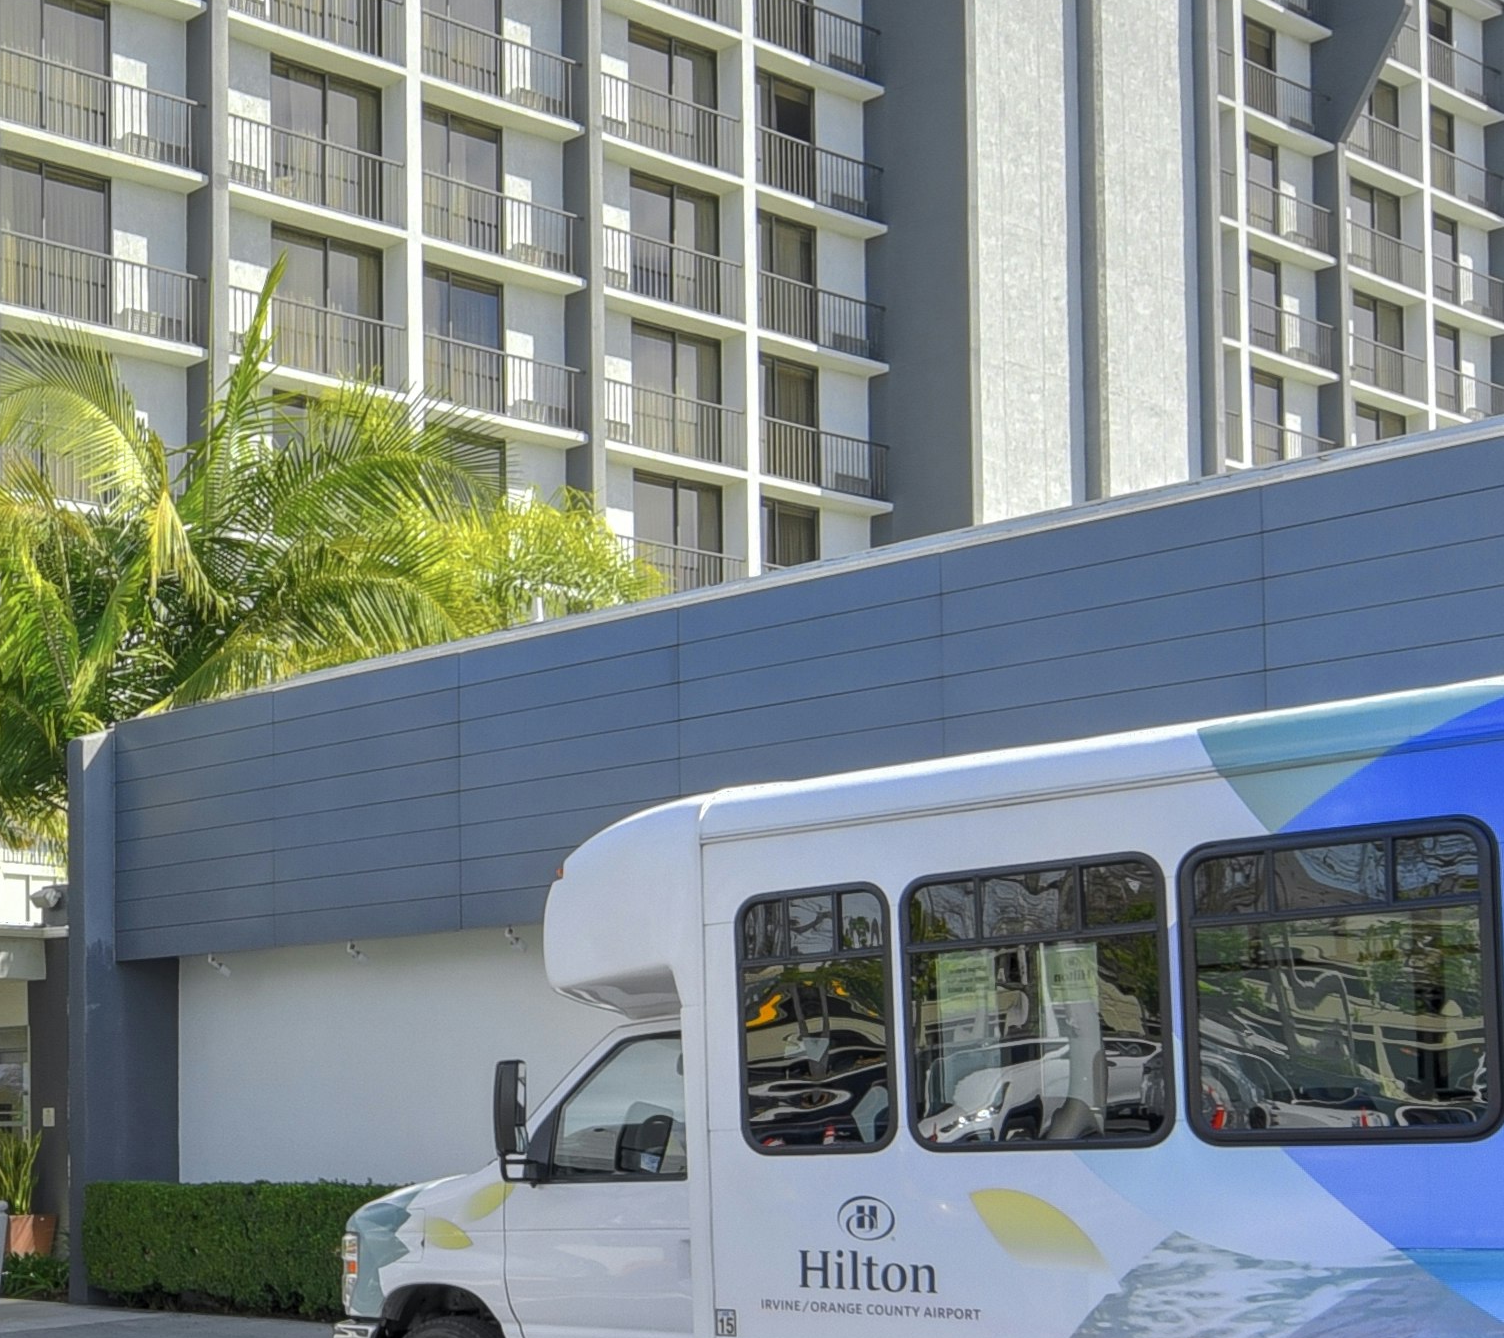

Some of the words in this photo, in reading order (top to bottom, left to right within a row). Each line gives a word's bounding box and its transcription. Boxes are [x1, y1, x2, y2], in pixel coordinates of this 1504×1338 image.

[798, 1249, 939, 1294] Hilton
[866, 1303, 921, 1318] COUNTY
[923, 1306, 982, 1321] AIRPORT
[719, 1317, 734, 1334] 15
